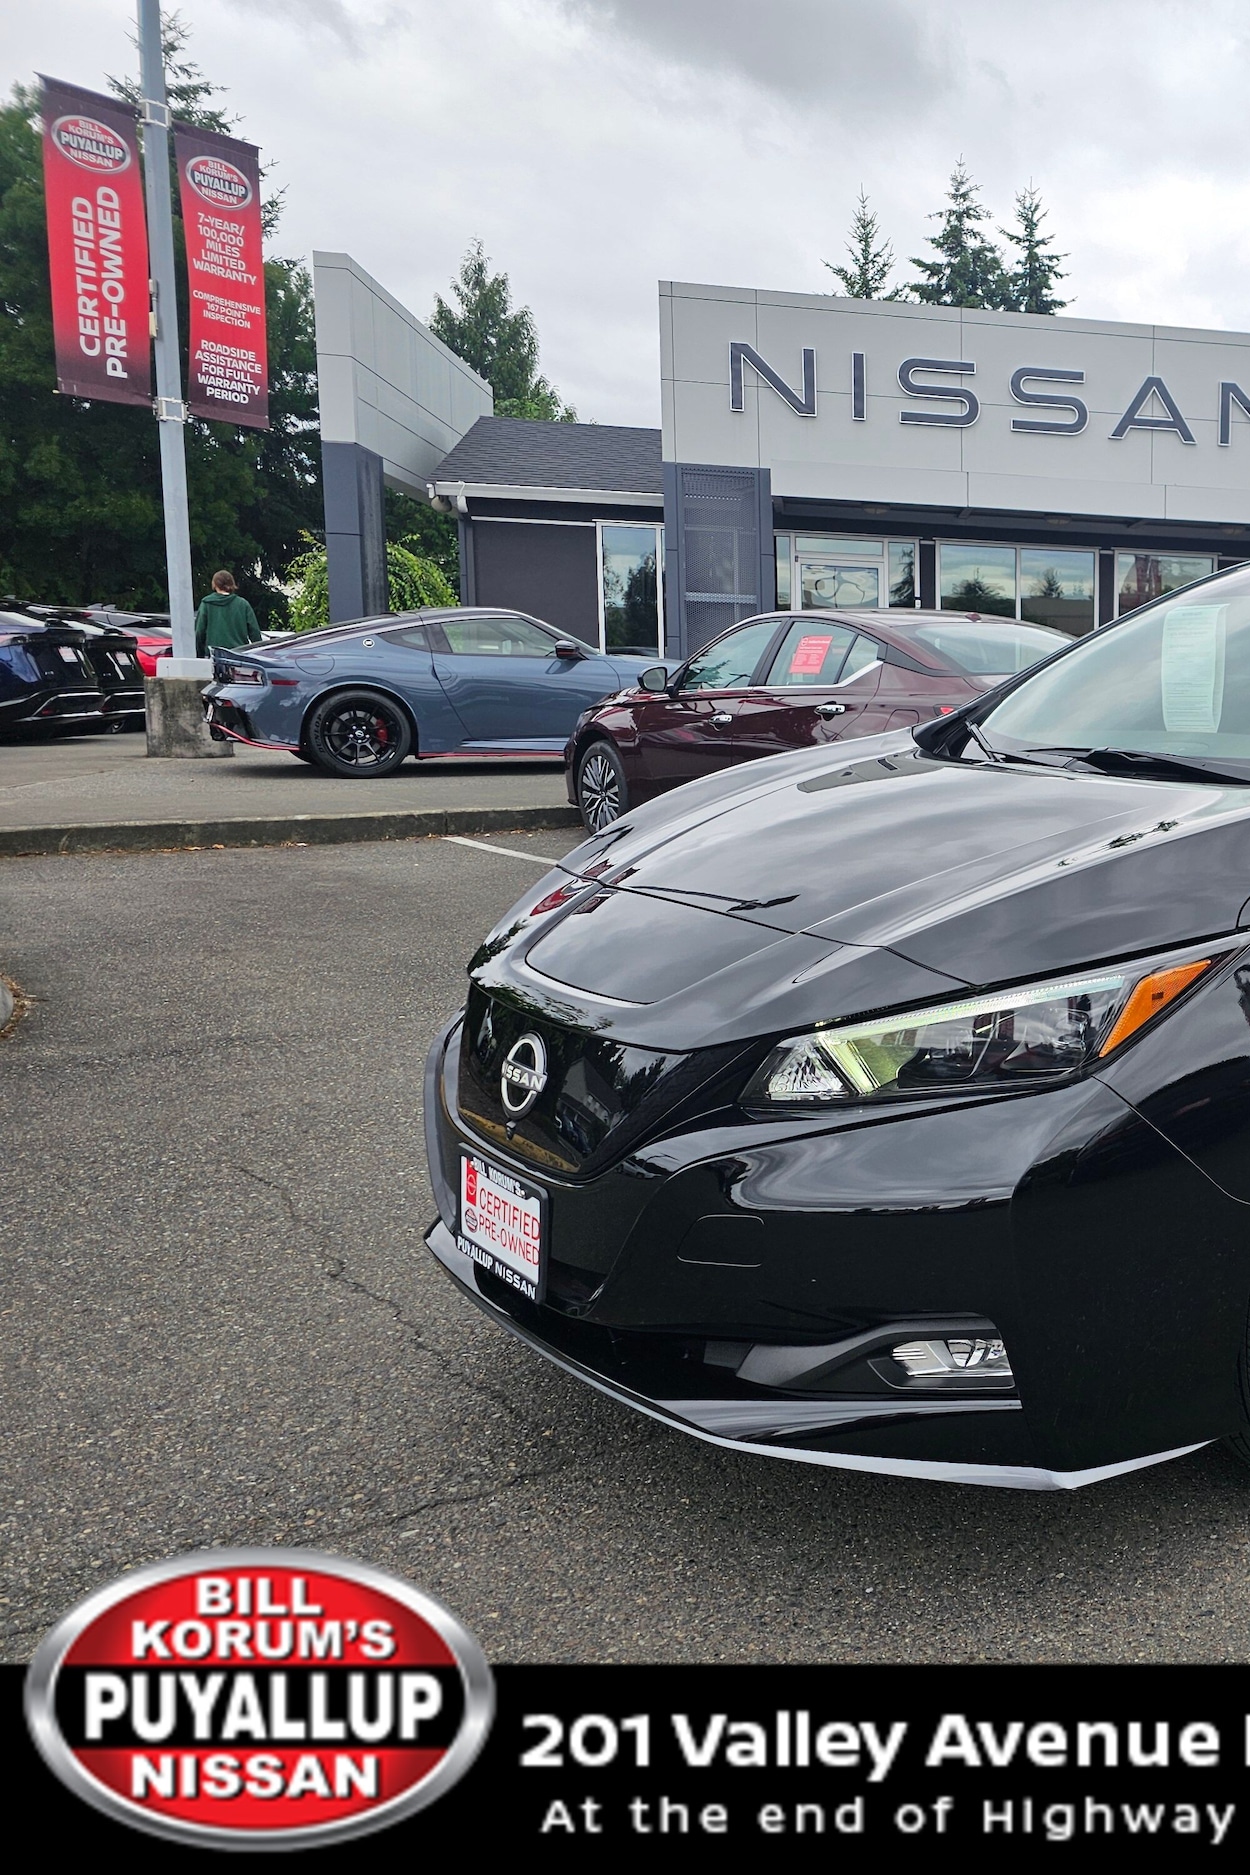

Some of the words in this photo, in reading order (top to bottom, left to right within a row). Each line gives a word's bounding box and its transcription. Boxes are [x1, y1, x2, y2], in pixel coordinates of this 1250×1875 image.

[68, 124, 114, 146] KORUM'S
[78, 118, 102, 134] BILL
[60, 132, 124, 159] PUYALLUP
[69, 148, 113, 168] NISSAN
[207, 160, 227, 173] BILL
[194, 171, 246, 197] PUYALLUP
[199, 165, 239, 183] KORUM'S
[201, 186, 238, 204] NISSAN
[197, 212, 245, 236] 7-YEAR/
[198, 224, 244, 248] 100,000
[205, 237, 241, 257] MILES
[193, 257, 257, 286] WARRANTY
[201, 249, 246, 271] LIMITED
[71, 196, 101, 357] CERTIFIED
[96, 186, 128, 379] PRE-OWNED
[192, 289, 261, 315] COMPREHENSIVE
[206, 301, 220, 313] 167
[220, 304, 247, 320] POINT
[203, 309, 251, 329] INSPECTION
[194, 350, 262, 374] ASSISTANCE
[201, 339, 256, 362] ROADSIDE
[197, 373, 261, 396] WARRANTY
[201, 362, 225, 379] FOR
[225, 367, 254, 384] FULL
[206, 386, 250, 404] PERIOD
[479, 1187, 540, 1241] CERTIFIED
[478, 1213, 540, 1266] PRE-OWNED
[457, 1235, 493, 1270] PUYALLUP
[495, 1261, 536, 1300] NISSAN
